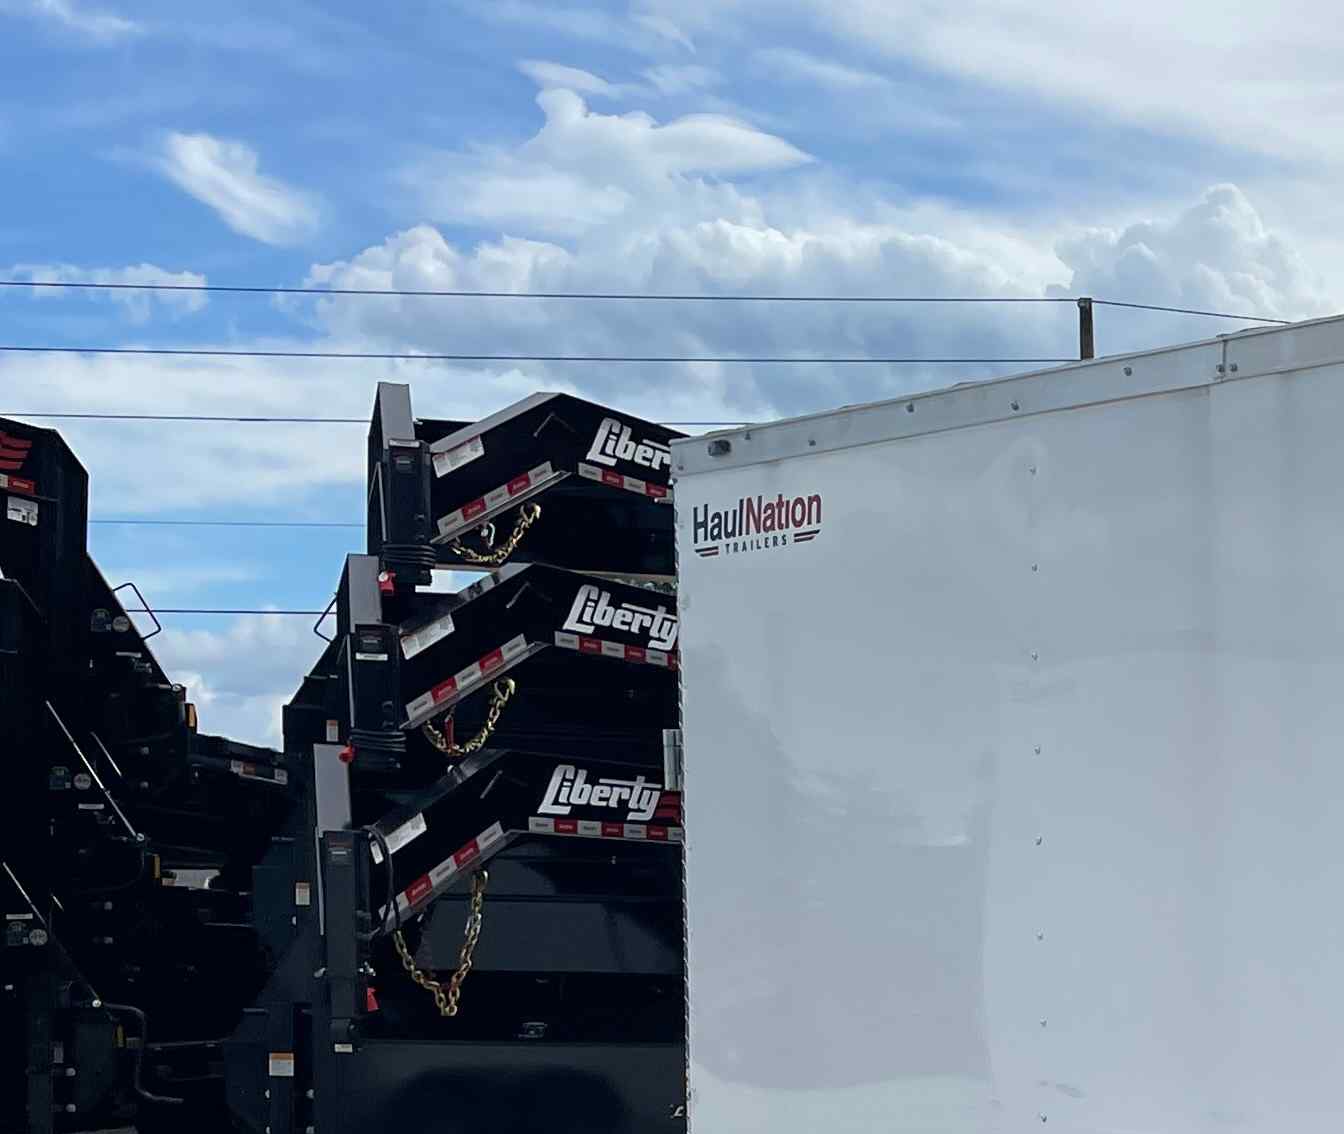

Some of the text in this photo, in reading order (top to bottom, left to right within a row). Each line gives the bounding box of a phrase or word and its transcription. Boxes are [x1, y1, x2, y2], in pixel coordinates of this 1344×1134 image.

[586, 417, 671, 470] Liber
[693, 494, 821, 544] HaulNation
[726, 534, 787, 555] TRAILERS
[562, 584, 678, 651] Liberty
[537, 764, 662, 821] Liberty
